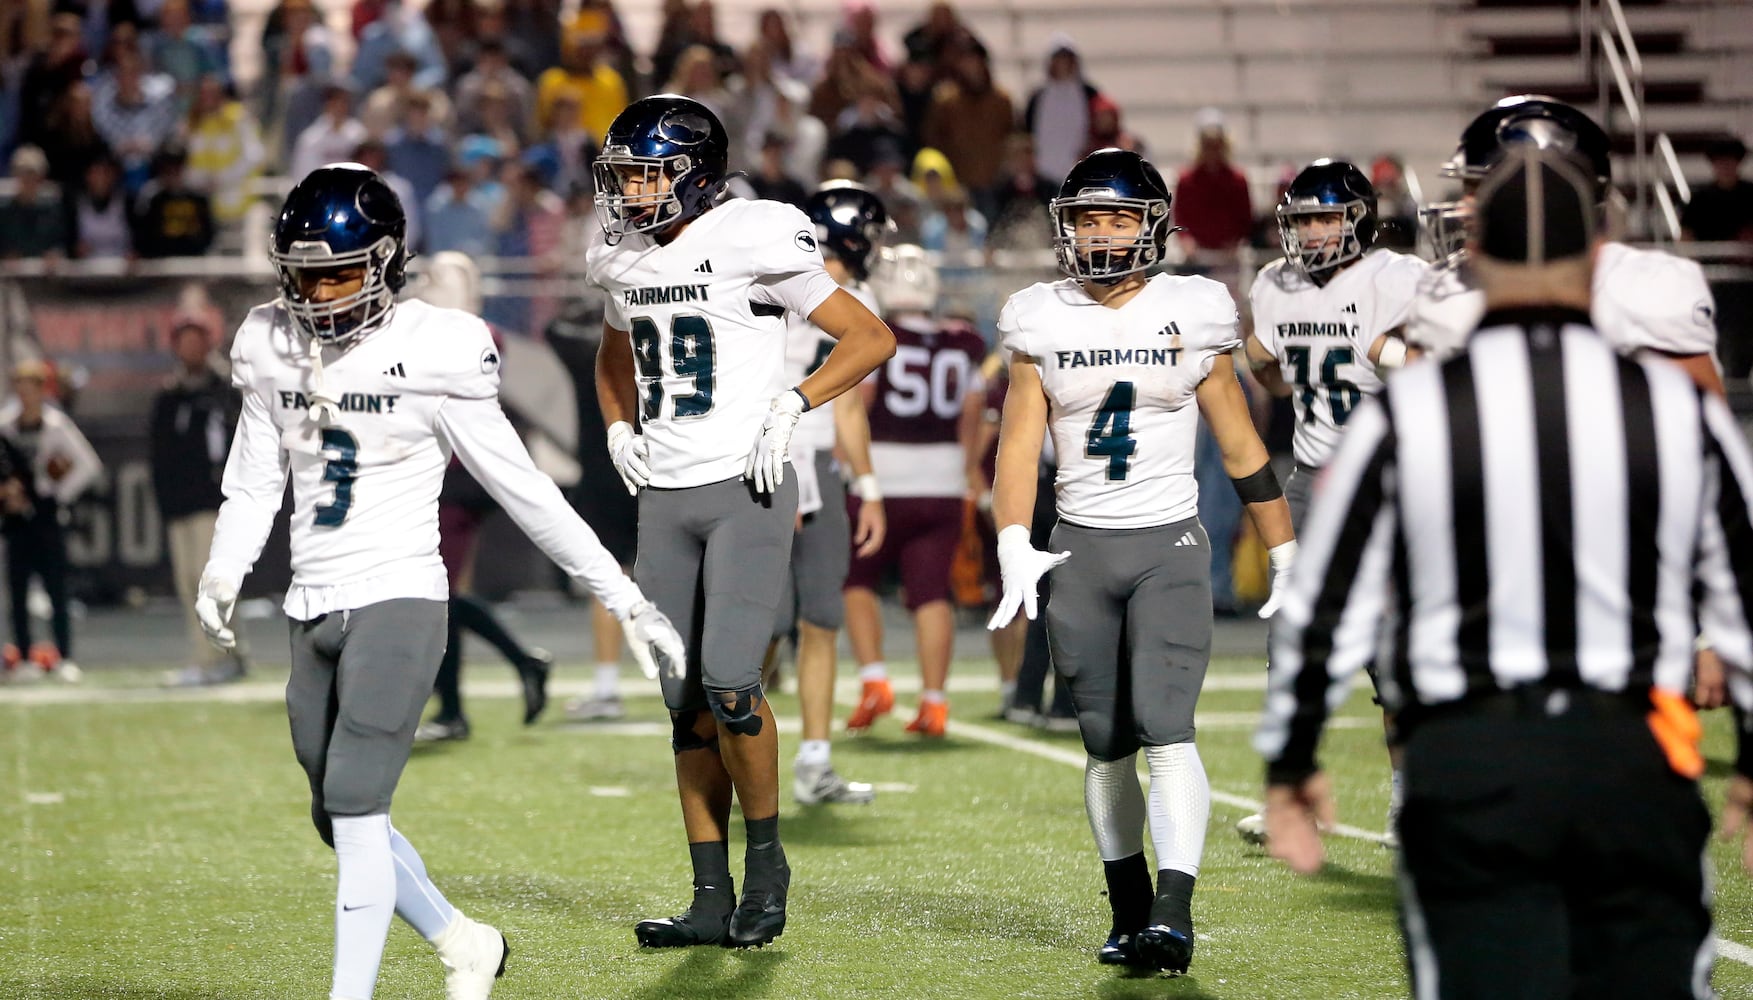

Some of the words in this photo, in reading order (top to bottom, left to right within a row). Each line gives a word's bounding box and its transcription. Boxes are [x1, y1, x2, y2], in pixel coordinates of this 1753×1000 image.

[624, 284, 710, 307] FAIRMONT
[630, 311, 717, 424] 99
[885, 343, 971, 419] 50
[1055, 347, 1184, 370] FAIRMONT
[278, 390, 400, 413] FAMONT
[1085, 380, 1139, 484] 4
[312, 425, 360, 532] 3
